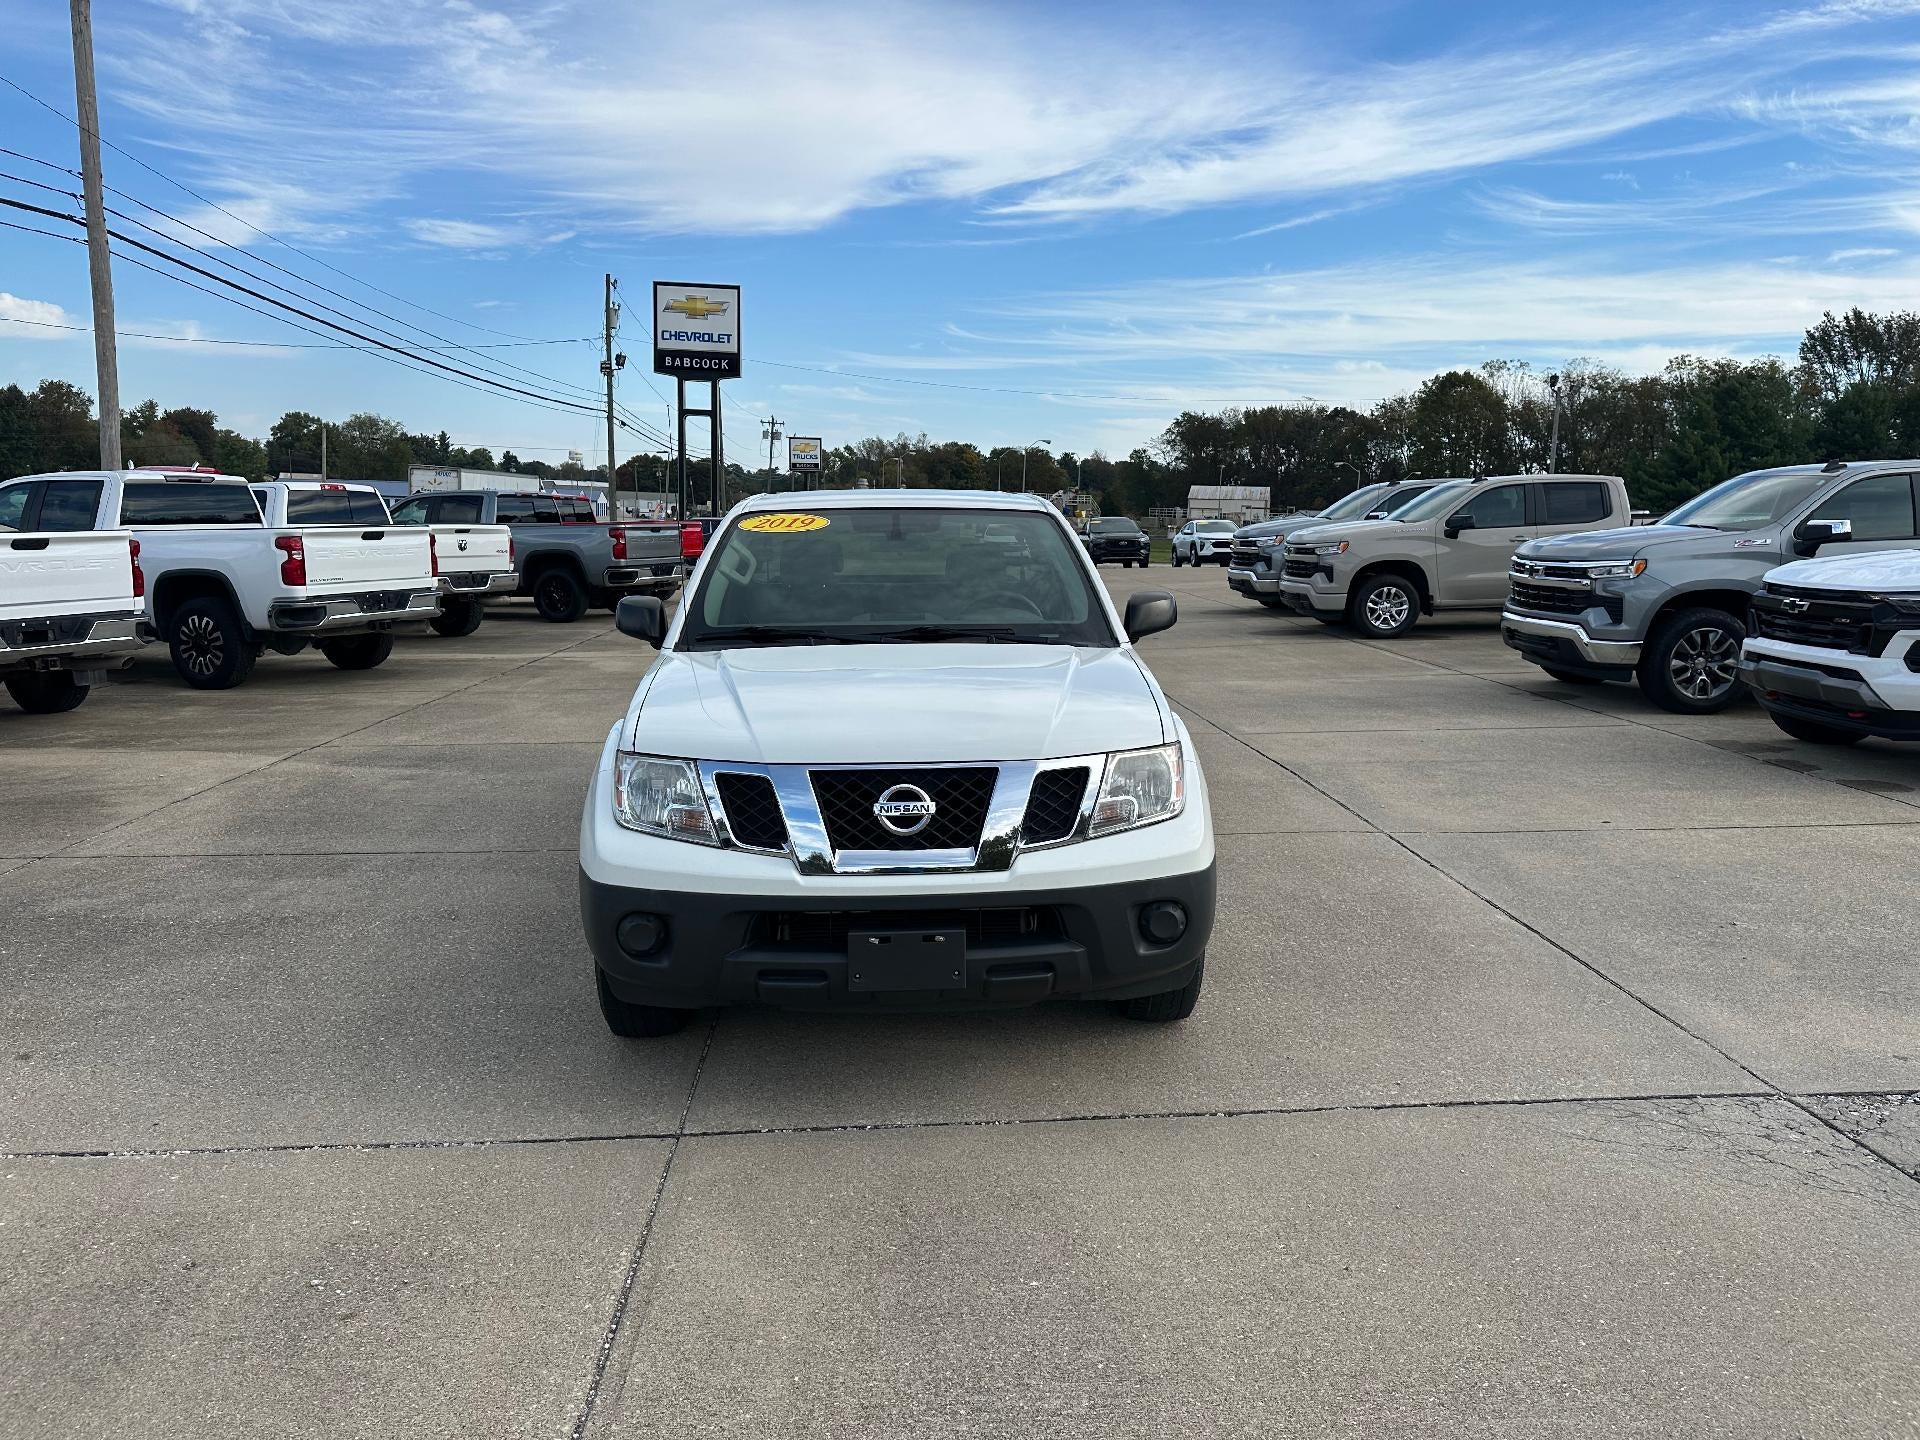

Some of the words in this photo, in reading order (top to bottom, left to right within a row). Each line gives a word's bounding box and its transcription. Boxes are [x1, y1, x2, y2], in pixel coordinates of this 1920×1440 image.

[661, 329, 733, 344] CHEVROLET
[665, 356, 729, 370] BABCOCK
[752, 517, 816, 529] 2019
[879, 804, 930, 814] NISSAN
